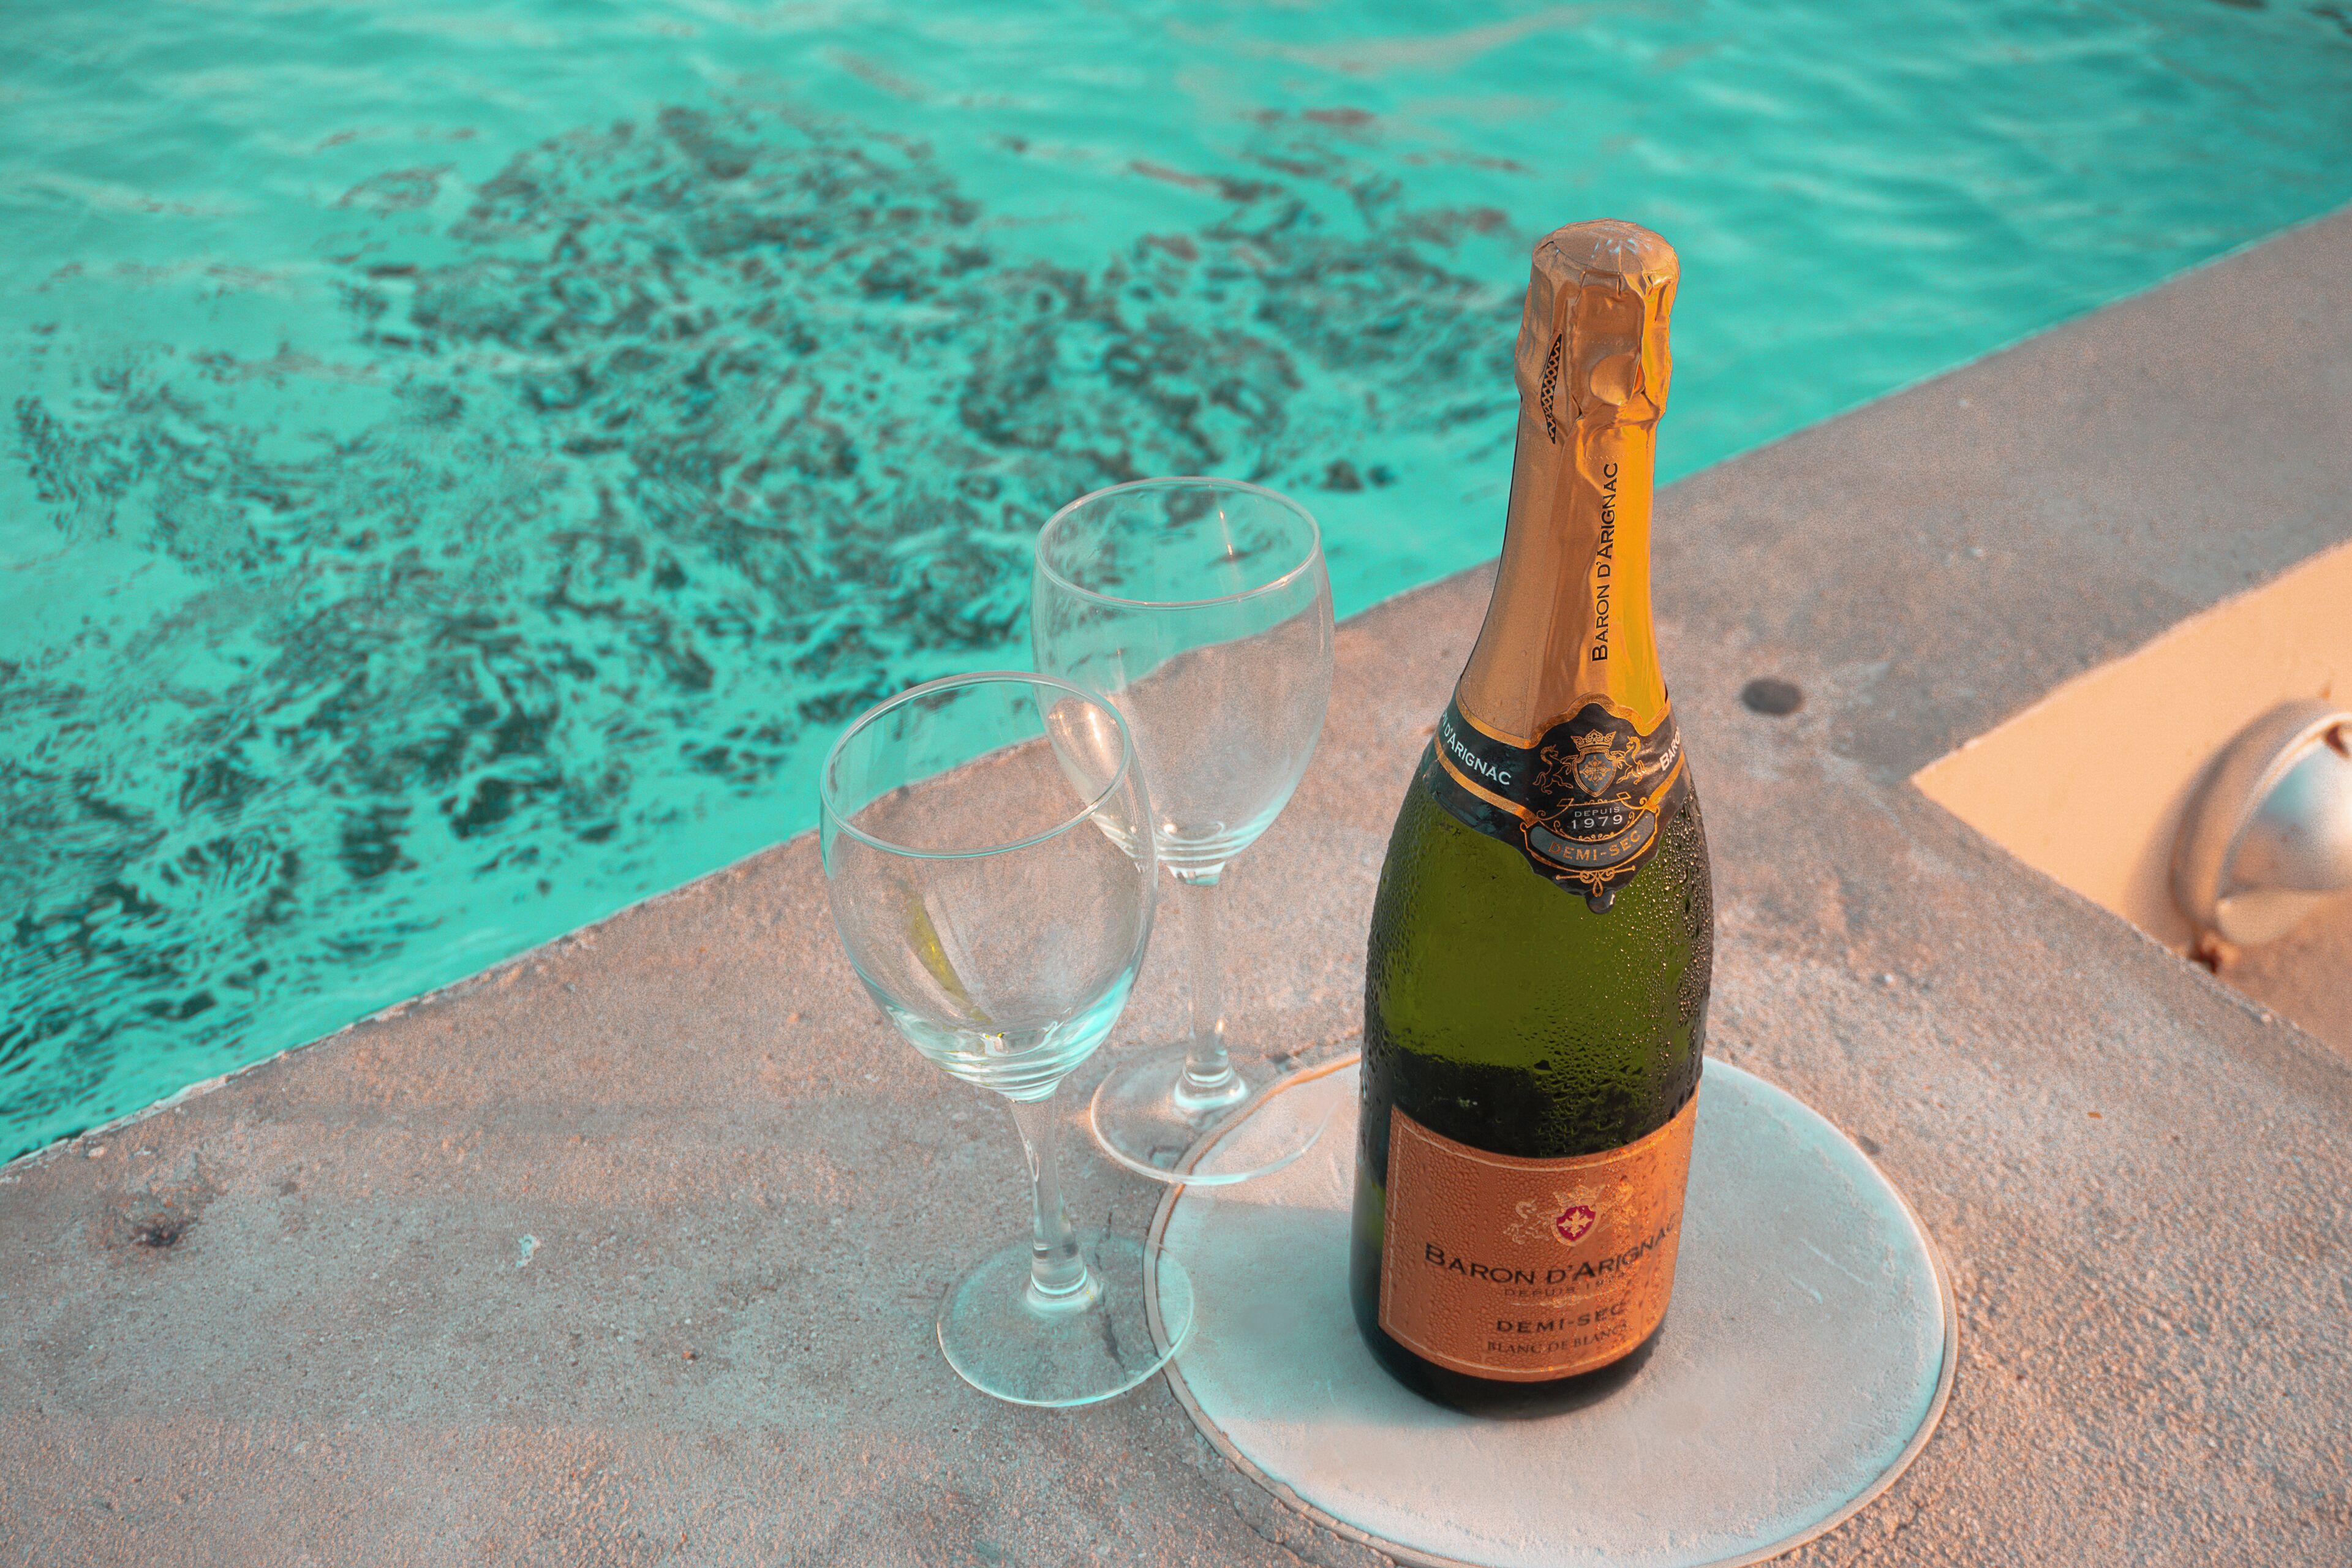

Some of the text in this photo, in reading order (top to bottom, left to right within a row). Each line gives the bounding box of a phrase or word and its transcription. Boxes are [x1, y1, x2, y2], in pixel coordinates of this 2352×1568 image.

[1593, 462, 1618, 662] BARON D'ARIGNAC
[1444, 723, 1511, 785] D'ARIGNAC
[1659, 726, 1679, 771] BARO
[1572, 815, 1623, 829] 1979
[1574, 807, 1620, 818] DEPUIS
[1548, 830, 1640, 861] DEMI-SEC
[1425, 1243, 1535, 1284] BARON
[1504, 1287, 1575, 1297] DEPUIS
[1497, 1302, 1626, 1333] DEMI-SEC
[1487, 1341, 1542, 1354] BLANC
